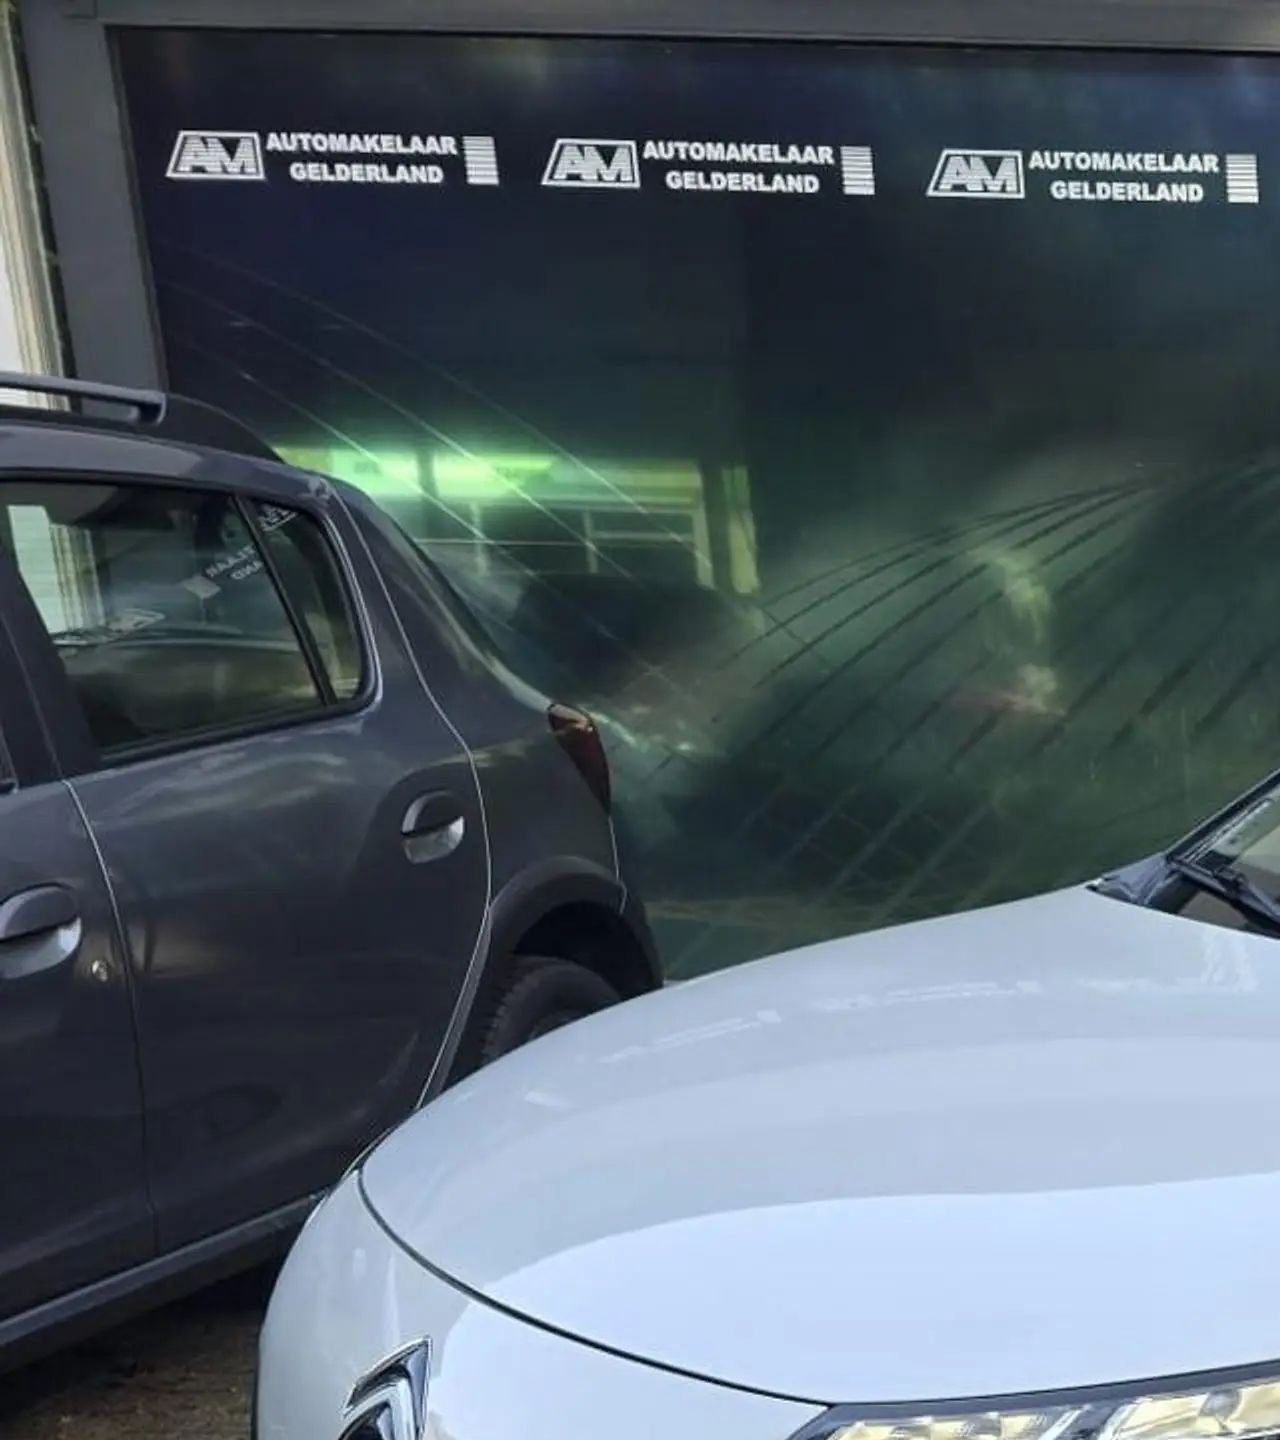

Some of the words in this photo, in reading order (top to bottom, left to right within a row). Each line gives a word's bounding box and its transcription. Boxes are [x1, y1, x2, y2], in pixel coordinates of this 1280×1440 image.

[265, 132, 459, 156] AUTOMAKELAAR
[642, 140, 836, 165] AUTOMAKELAAR
[289, 162, 445, 184] GELDERLAND
[1027, 150, 1221, 174] AUTOMAKELAAR
[665, 170, 821, 194] GELDERLAND
[1049, 179, 1206, 203] GELDERLAND
